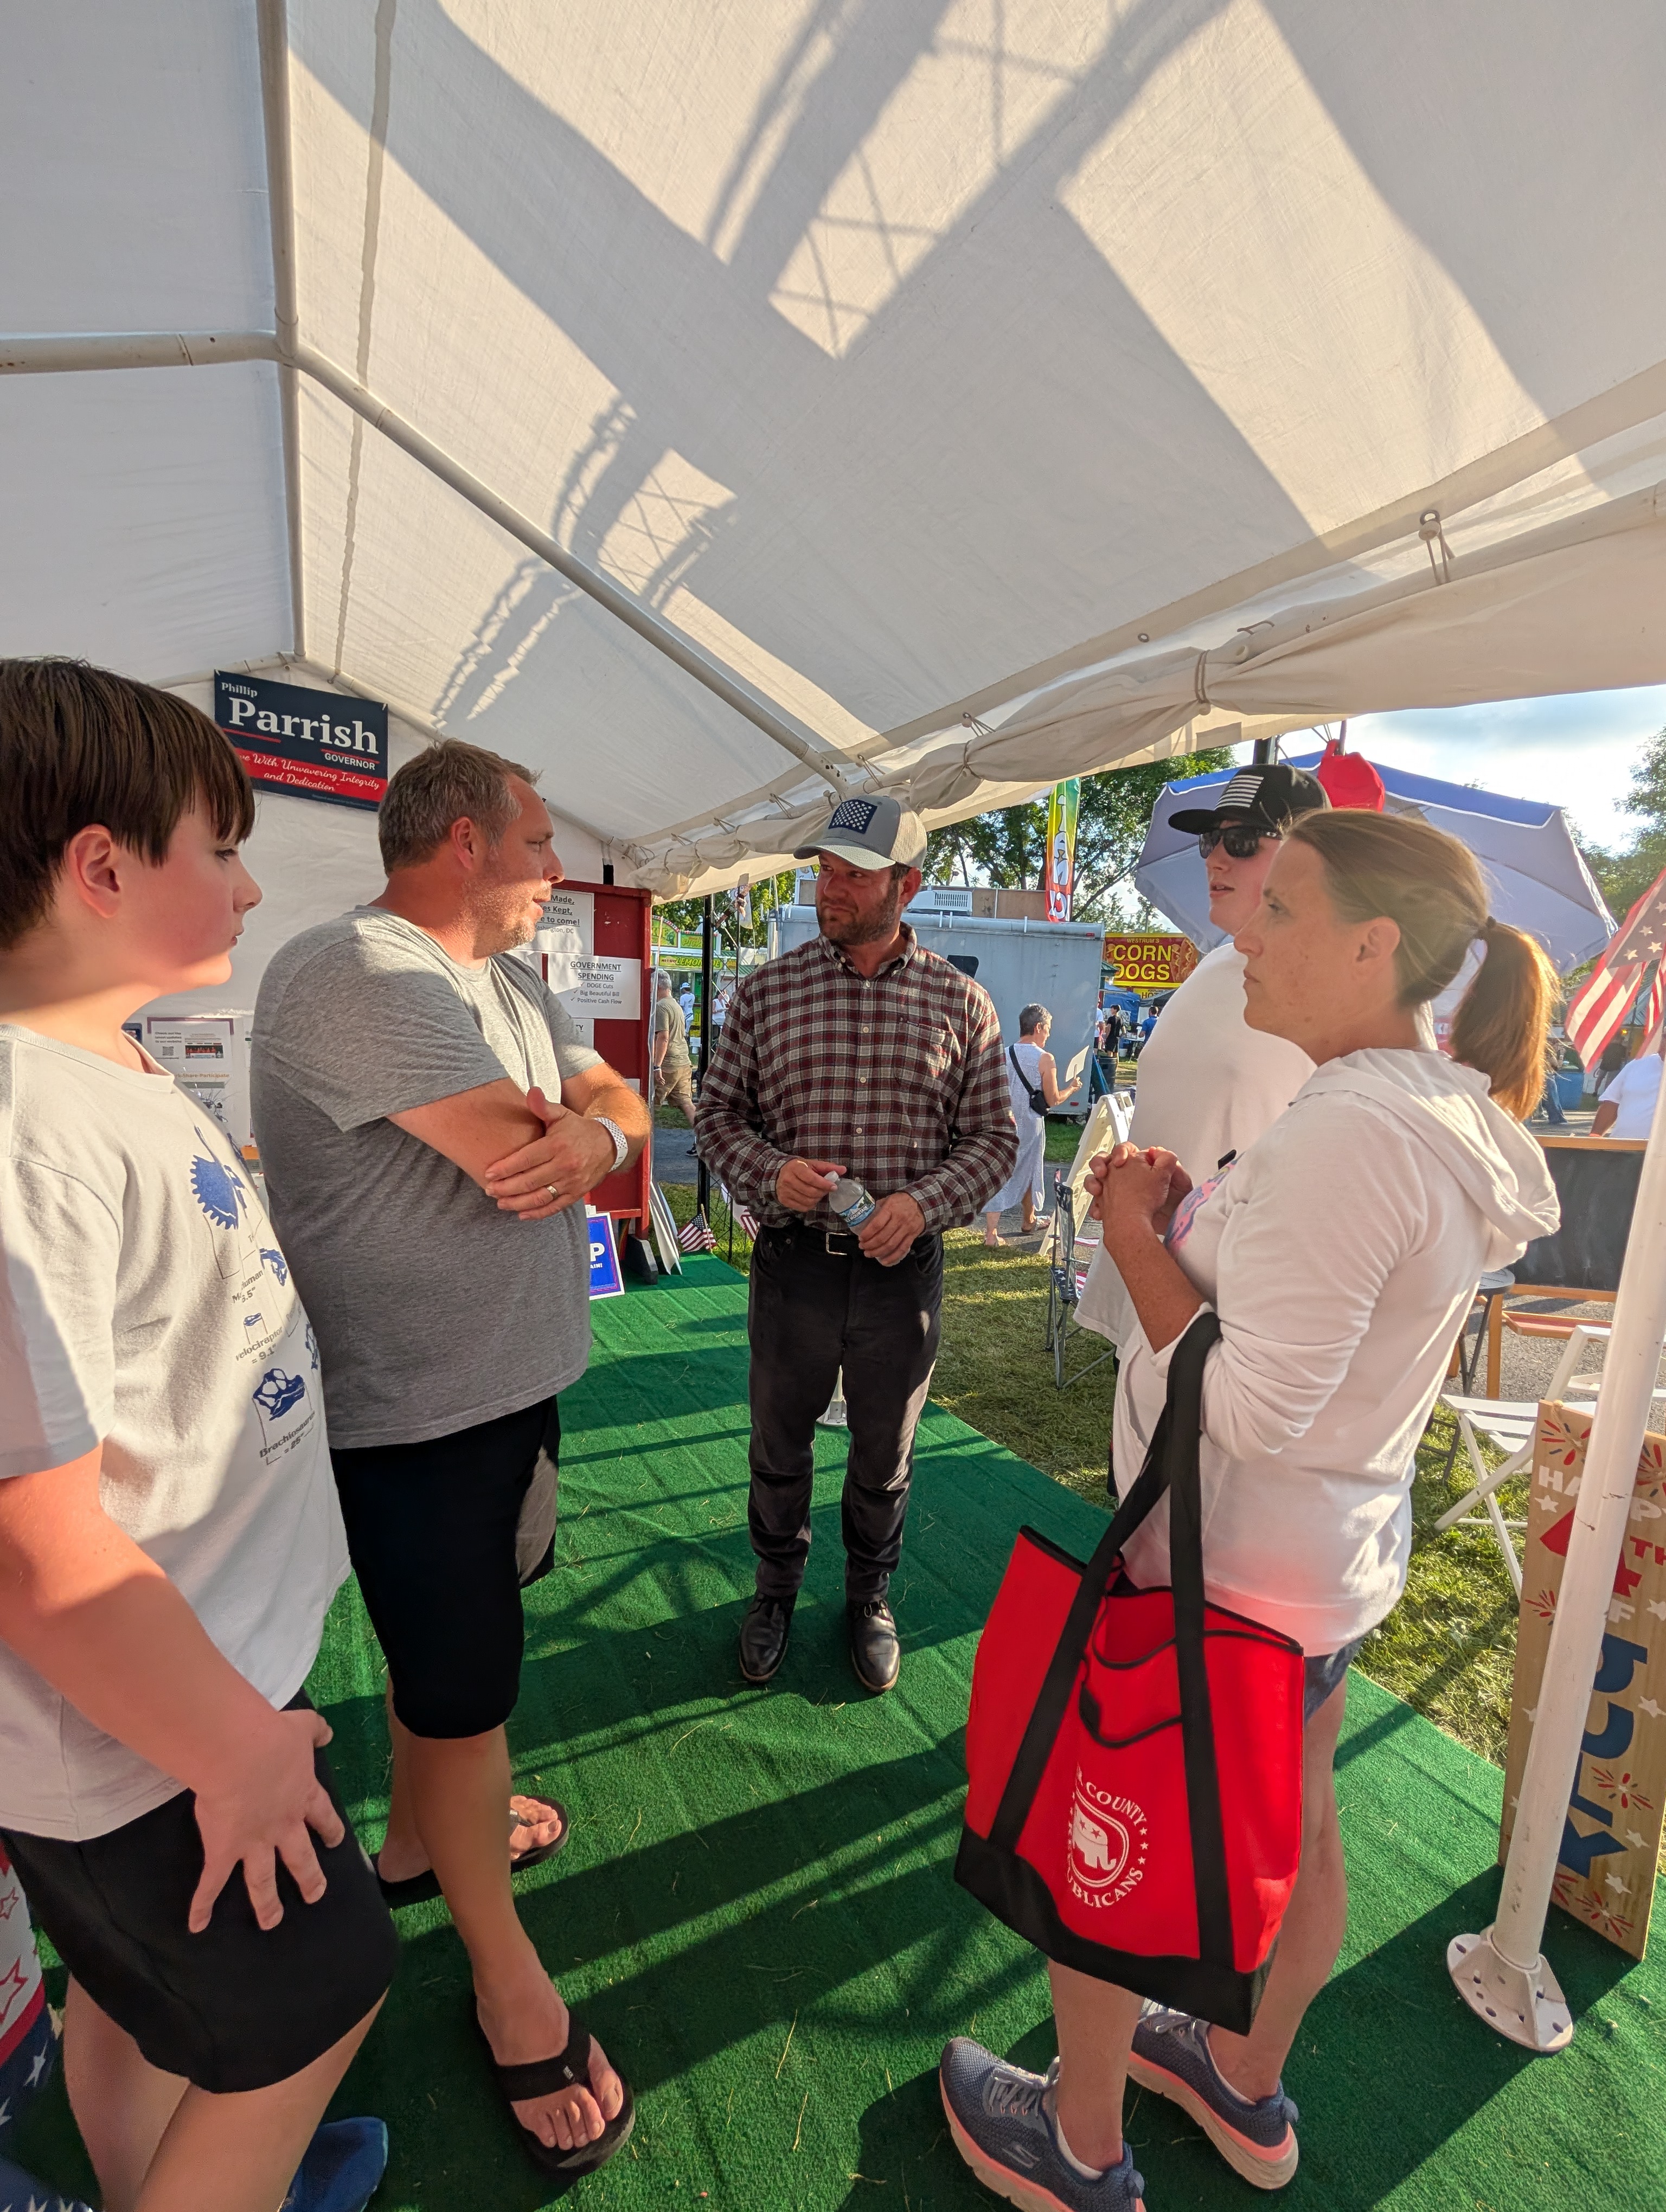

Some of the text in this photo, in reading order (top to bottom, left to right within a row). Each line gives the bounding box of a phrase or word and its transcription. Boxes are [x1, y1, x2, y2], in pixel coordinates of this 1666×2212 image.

[221, 682, 258, 698] Phillip
[229, 697, 379, 754] Parrish
[324, 753, 375, 770] GOVERNOR
[253, 754, 279, 768] With
[281, 760, 337, 782] Unwavering
[340, 772, 380, 790] Integrity
[264, 772, 284, 781] and
[551, 895, 575, 905] Made,
[553, 906, 573, 916] Kept,
[535, 924, 565, 933] ashington,
[1113, 944, 1171, 961] CORN
[570, 961, 621, 971] GOVERNMENT
[1113, 963, 1170, 980] DOGS
[578, 973, 614, 981] SPENDING
[1086, 1782, 1147, 1826] COUNTY
[1071, 1867, 1143, 1908] BLICANS
